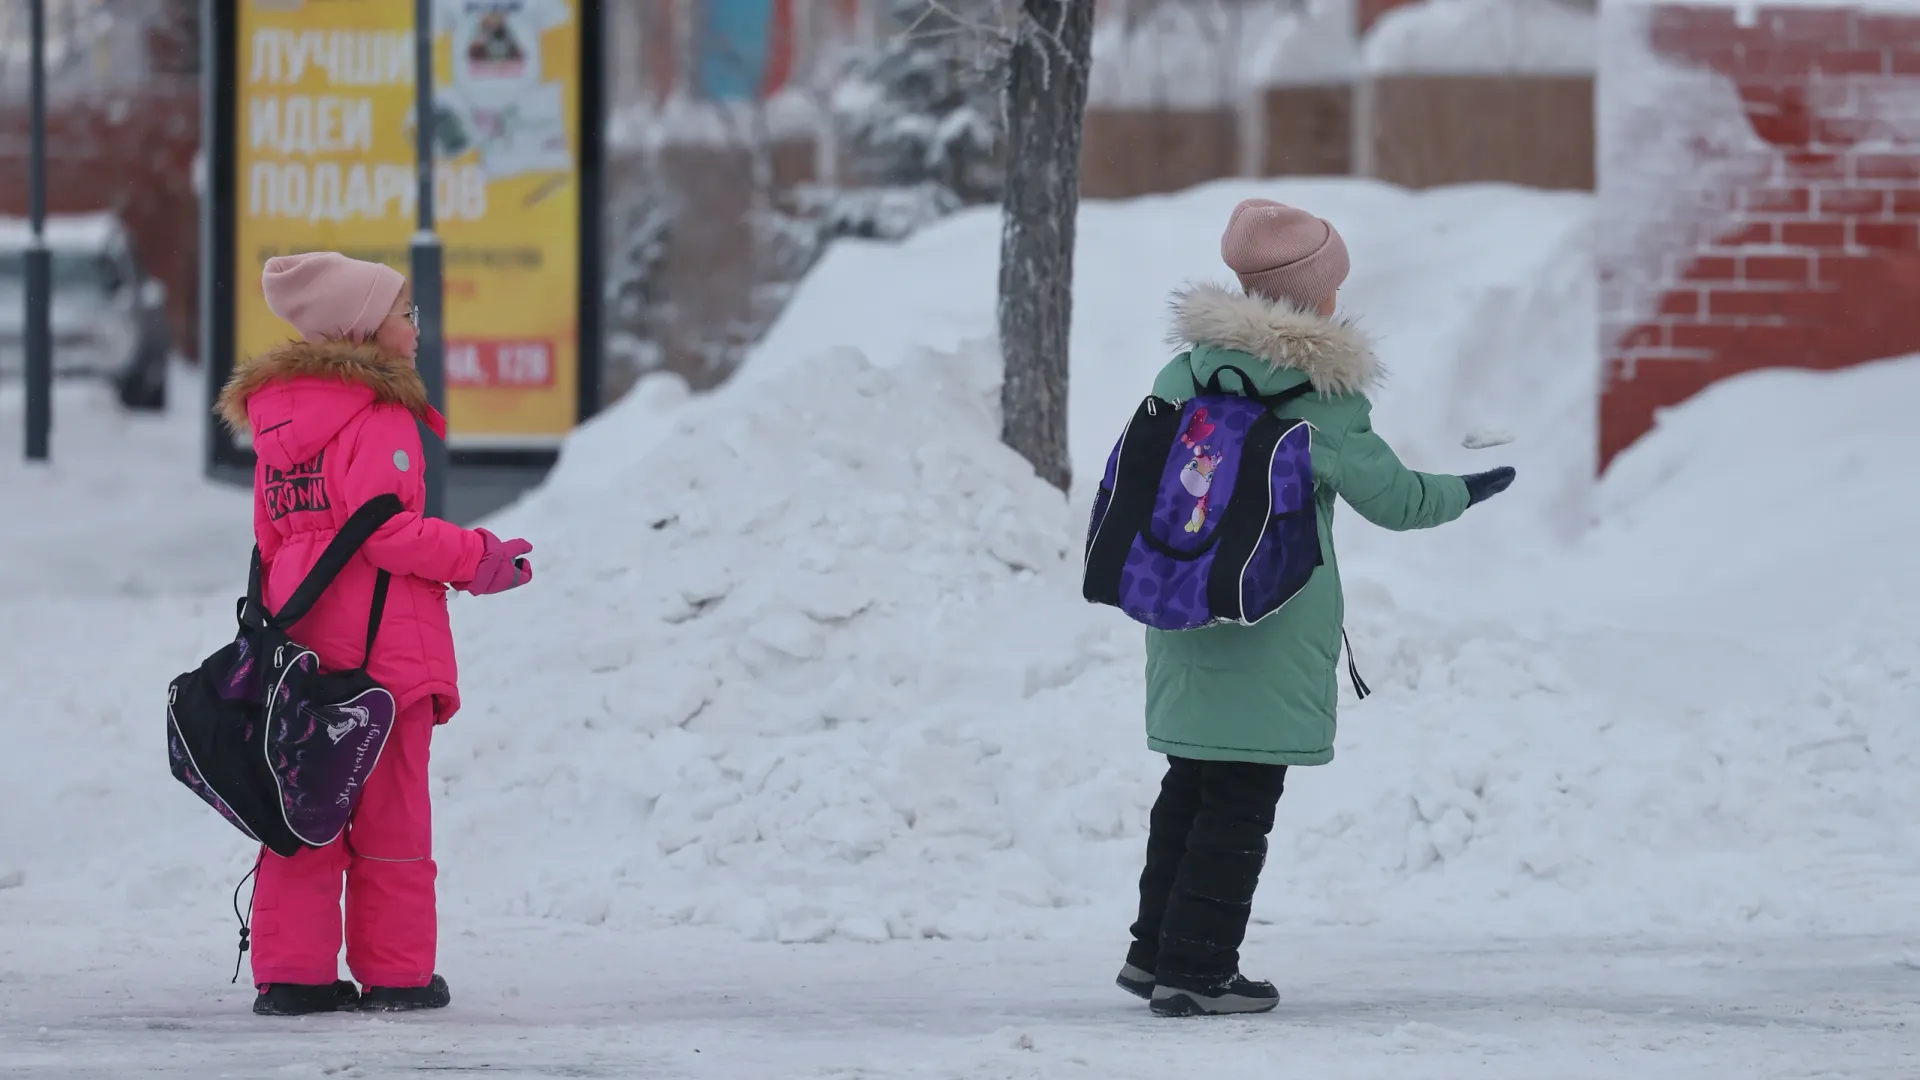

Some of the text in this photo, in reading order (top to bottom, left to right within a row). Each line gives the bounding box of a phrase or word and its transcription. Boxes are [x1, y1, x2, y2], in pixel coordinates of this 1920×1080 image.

[250, 29, 418, 85] ЛУЧШИ
[251, 95, 373, 154] ИДЕИ
[335, 723, 380, 809] Stop waiting!
